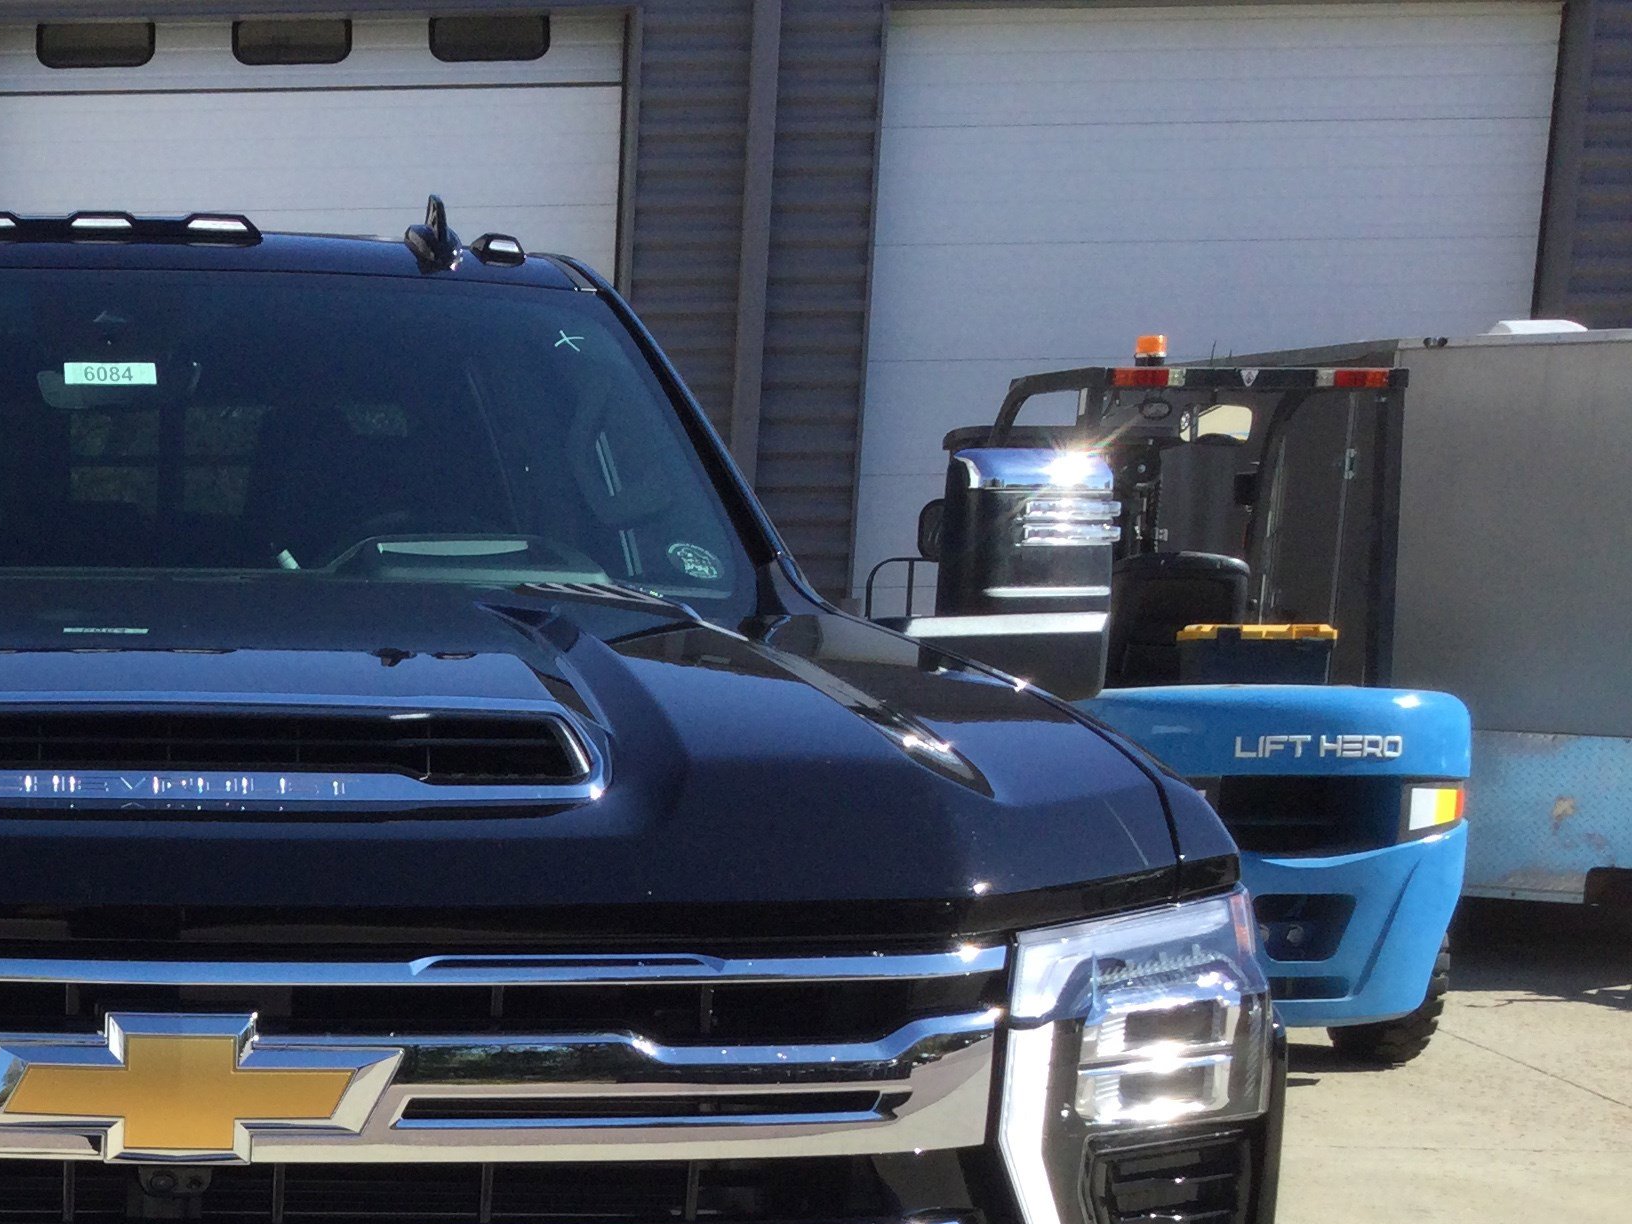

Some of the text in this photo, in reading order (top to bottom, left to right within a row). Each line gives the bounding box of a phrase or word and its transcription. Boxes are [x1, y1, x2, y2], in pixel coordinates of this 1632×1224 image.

[83, 366, 133, 381] 6084
[1234, 735, 1403, 758] LIFT HERO
